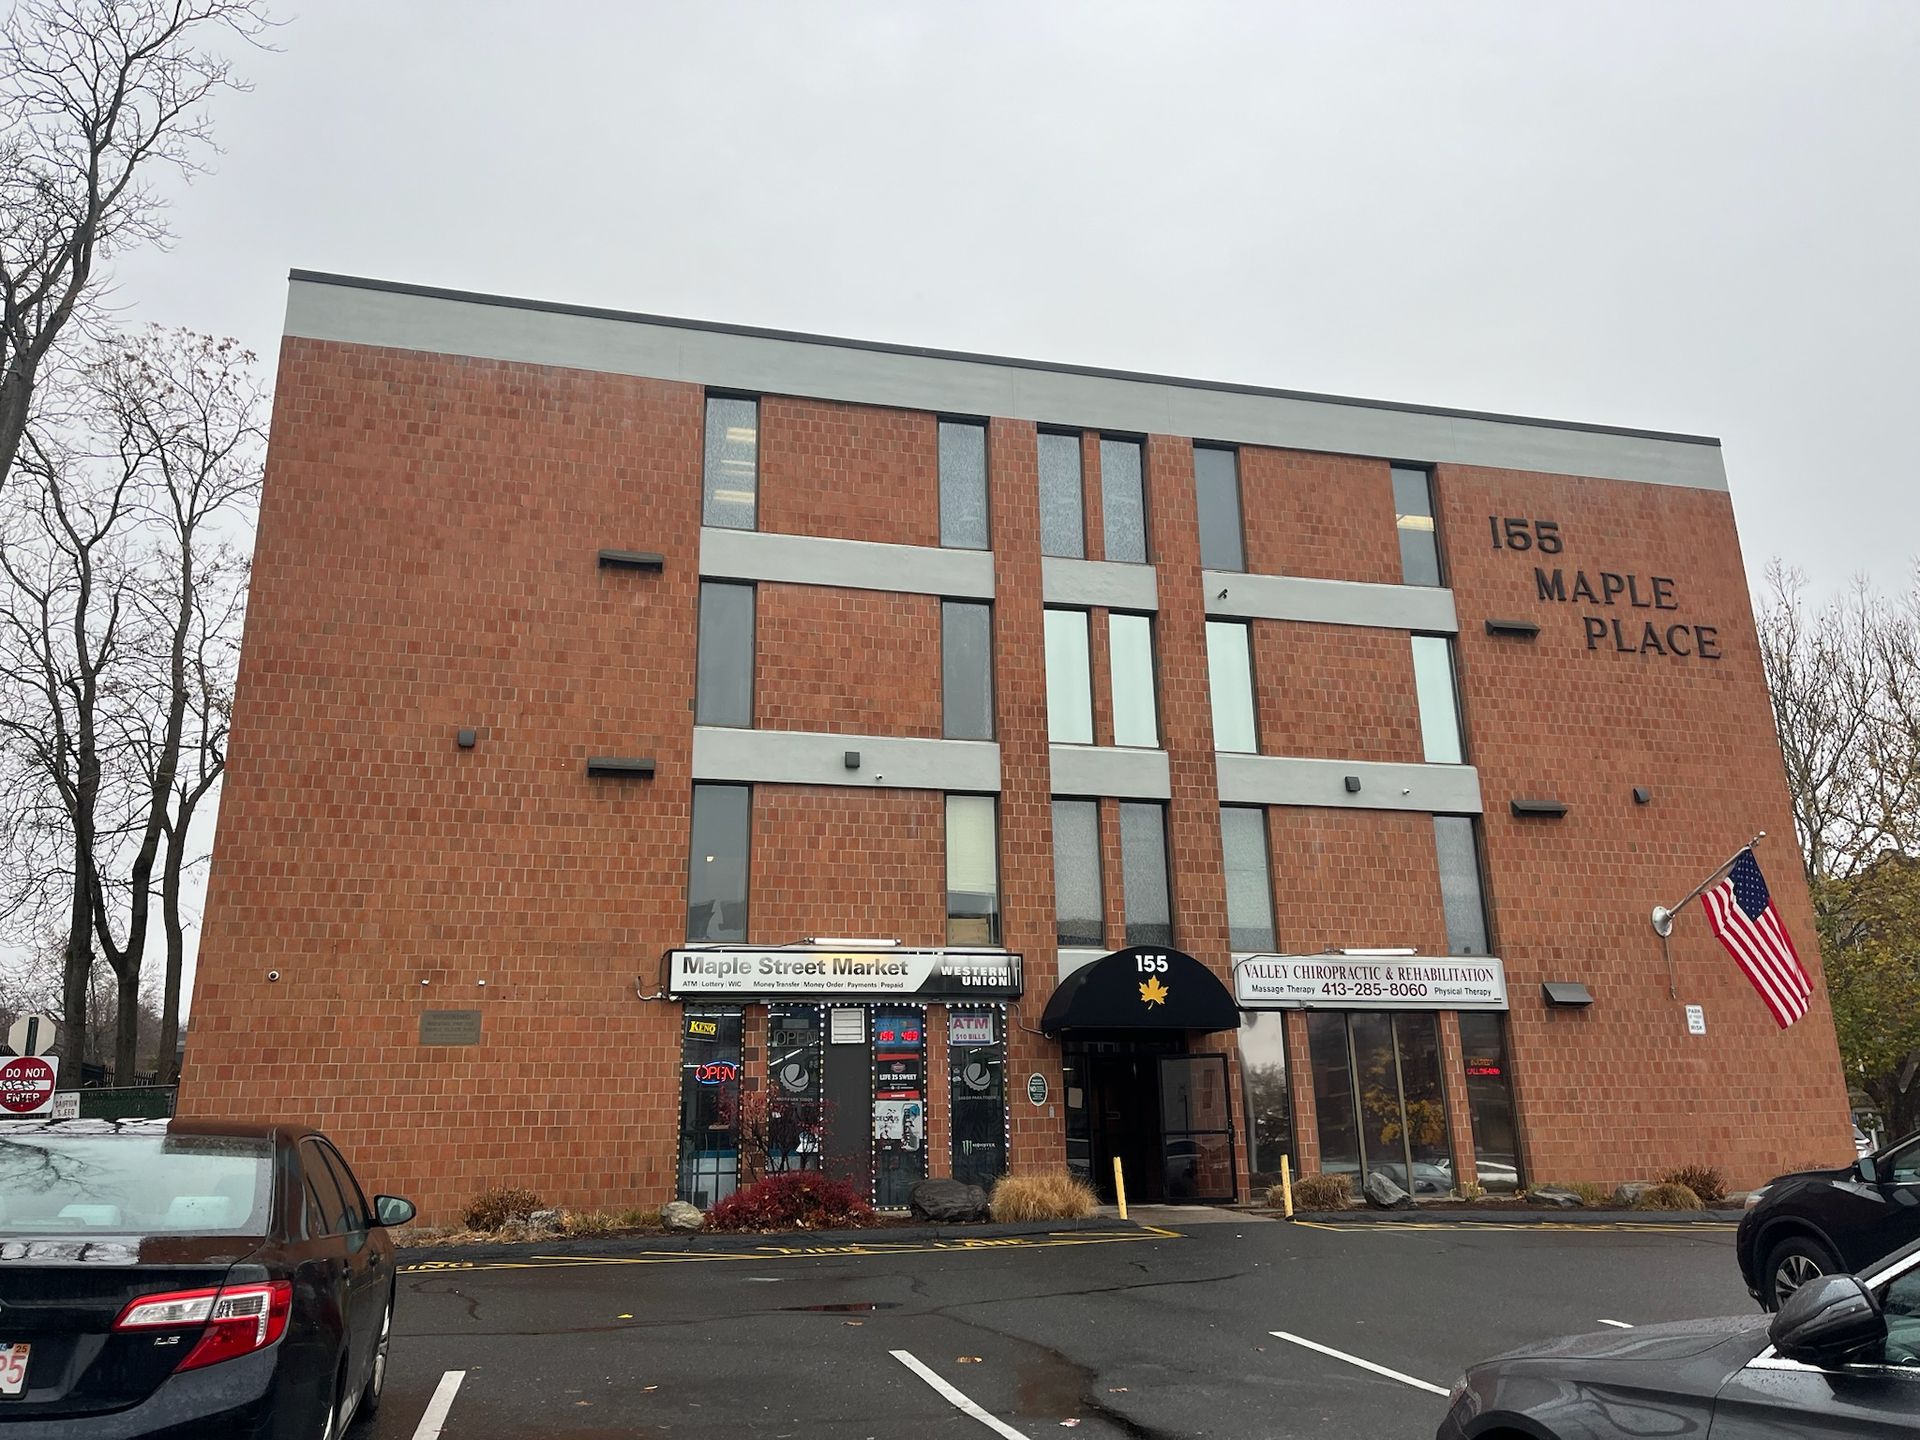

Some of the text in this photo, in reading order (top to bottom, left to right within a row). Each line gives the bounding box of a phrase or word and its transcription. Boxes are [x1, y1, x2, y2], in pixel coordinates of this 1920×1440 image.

[1489, 516, 1563, 554] 155
[1534, 567, 1679, 610] MAPLE
[1583, 616, 1721, 659] PLACE
[683, 956, 908, 978] Maple Street Market
[940, 966, 1007, 976] WESTERN
[1135, 955, 1169, 972] 155
[1244, 964, 1495, 982] VALLEY CHIROPRACTIC & REHABILITATION
[701, 981, 725, 989] Lottery
[962, 976, 1007, 986] UNION
[1252, 982, 1491, 997] Massage Therapy 413-285-8060 Physical Therapy
[689, 1020, 717, 1035] KENO
[953, 1018, 988, 1029] ATM
[775, 1030, 817, 1045] OPEN
[6, 1068, 46, 1078] DO NOT
[696, 1065, 737, 1080] OPEN
[57, 1108, 75, 1116] SEED
[16, 1345, 28, 1353] 25
